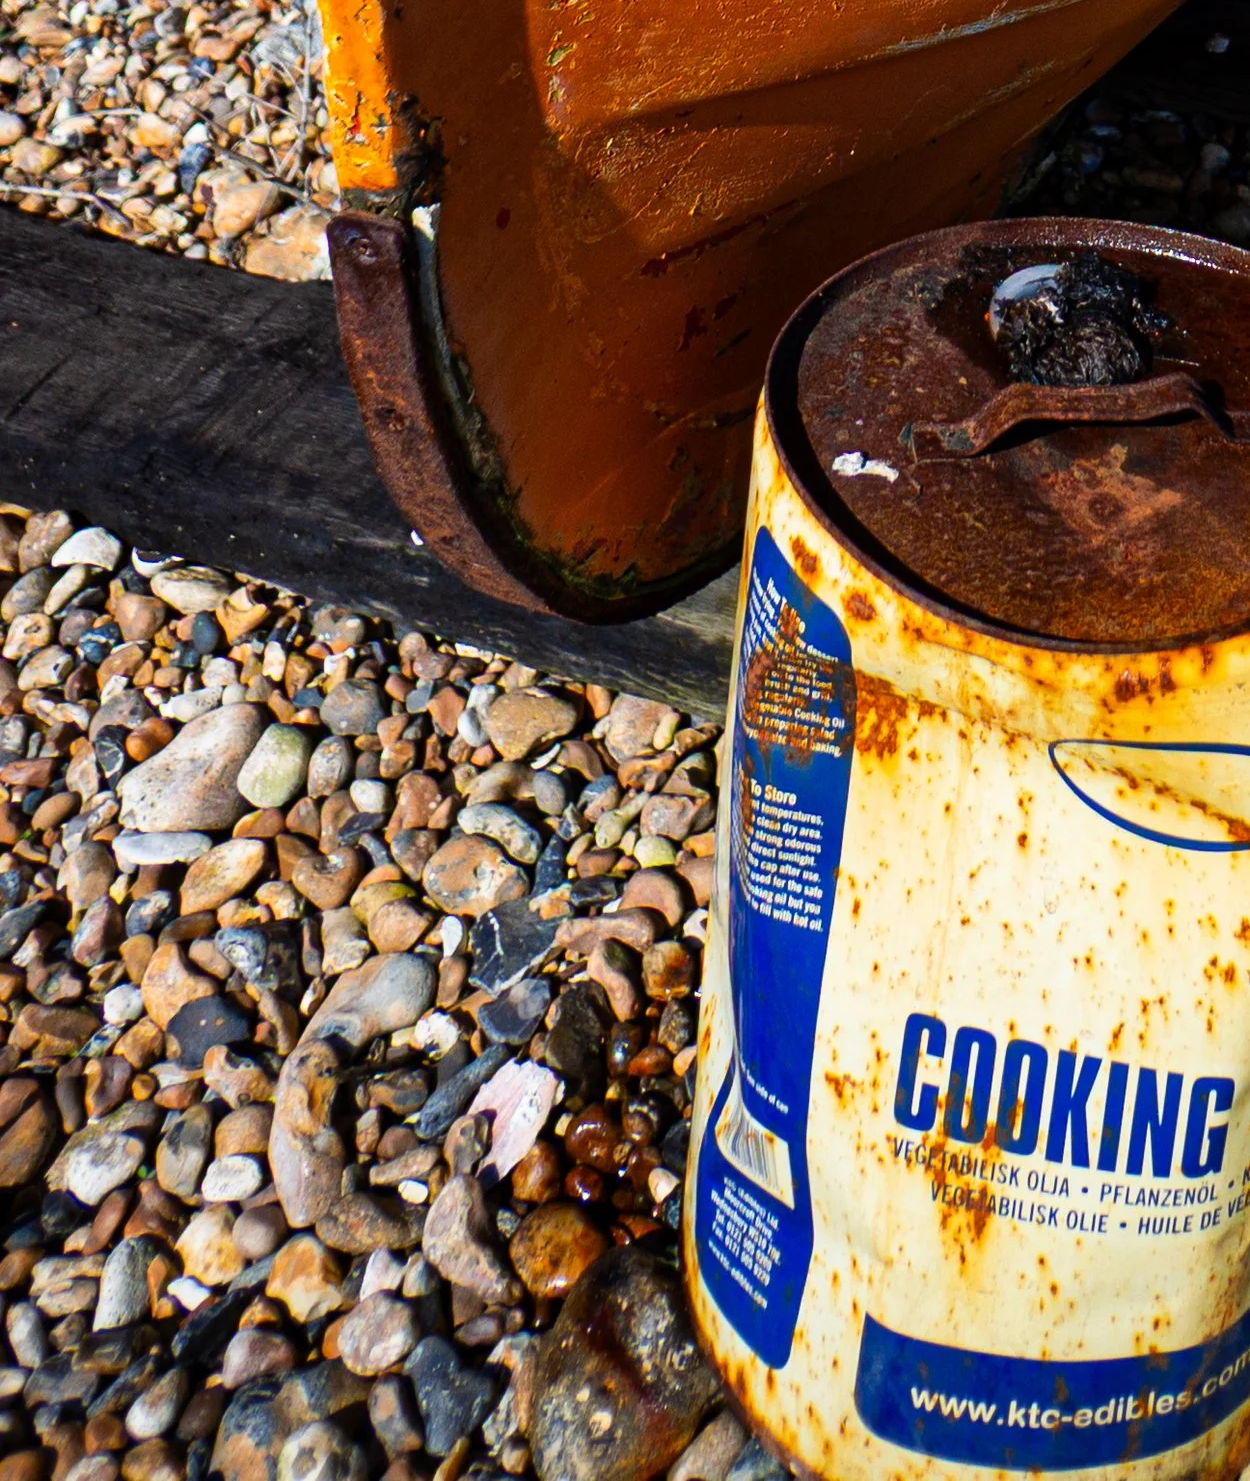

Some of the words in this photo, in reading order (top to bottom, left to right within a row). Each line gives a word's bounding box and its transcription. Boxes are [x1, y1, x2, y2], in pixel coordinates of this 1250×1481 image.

[832, 716, 845, 729] Oil
[764, 784, 797, 806] Store
[756, 816, 781, 831] clean
[782, 822, 799, 837] dry
[750, 841, 776, 859] direct
[755, 830, 783, 848] strong
[784, 837, 822, 854] odorous
[760, 860, 778, 874] cap
[779, 863, 802, 878] after
[773, 874, 787, 888] for
[787, 879, 803, 893] the
[803, 884, 823, 899] safe
[774, 891, 787, 905] oil
[788, 894, 804, 911] but
[804, 901, 821, 916] you
[772, 907, 792, 924] with
[793, 913, 809, 929] hot
[893, 1012, 1236, 1179] COOKING
[892, 1137, 1020, 1187] VEGETABILISK
[1026, 1169, 1070, 1198] OLJA
[1099, 1180, 1219, 1208] PFLANZENÖL
[929, 1180, 1059, 1228] VEGETABILISK
[1066, 1209, 1109, 1234] OLIE
[1137, 1211, 1193, 1235] HUILE
[1199, 1202, 1223, 1229] DE
